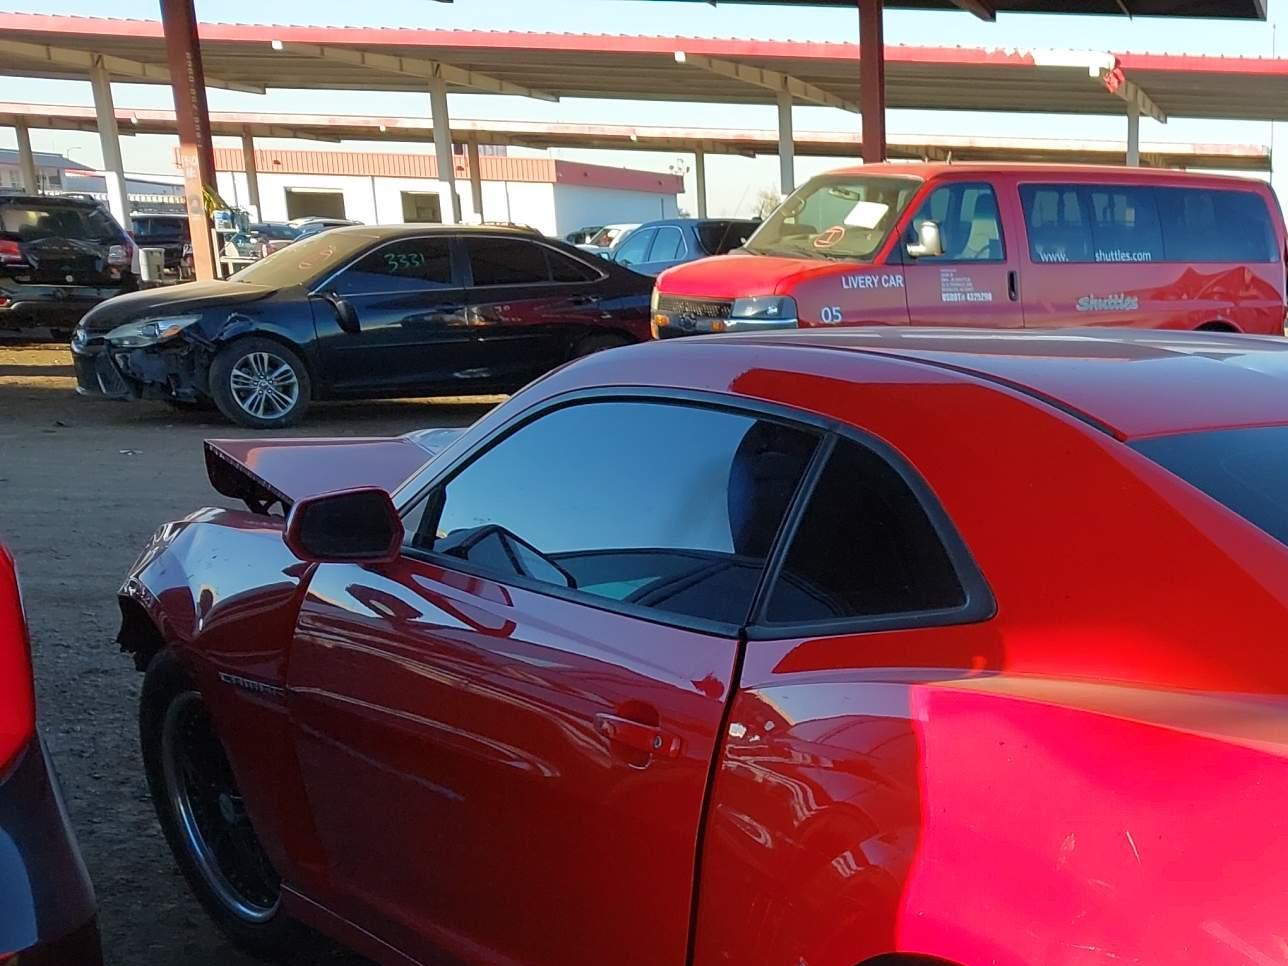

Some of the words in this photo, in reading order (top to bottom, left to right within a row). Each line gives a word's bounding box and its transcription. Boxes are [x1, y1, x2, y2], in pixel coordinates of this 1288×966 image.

[1095, 248, 1152, 262] shuttles.com
[841, 275, 879, 289] LIVERY
[881, 274, 905, 288] CAR
[1076, 293, 1139, 312] Shuttles
